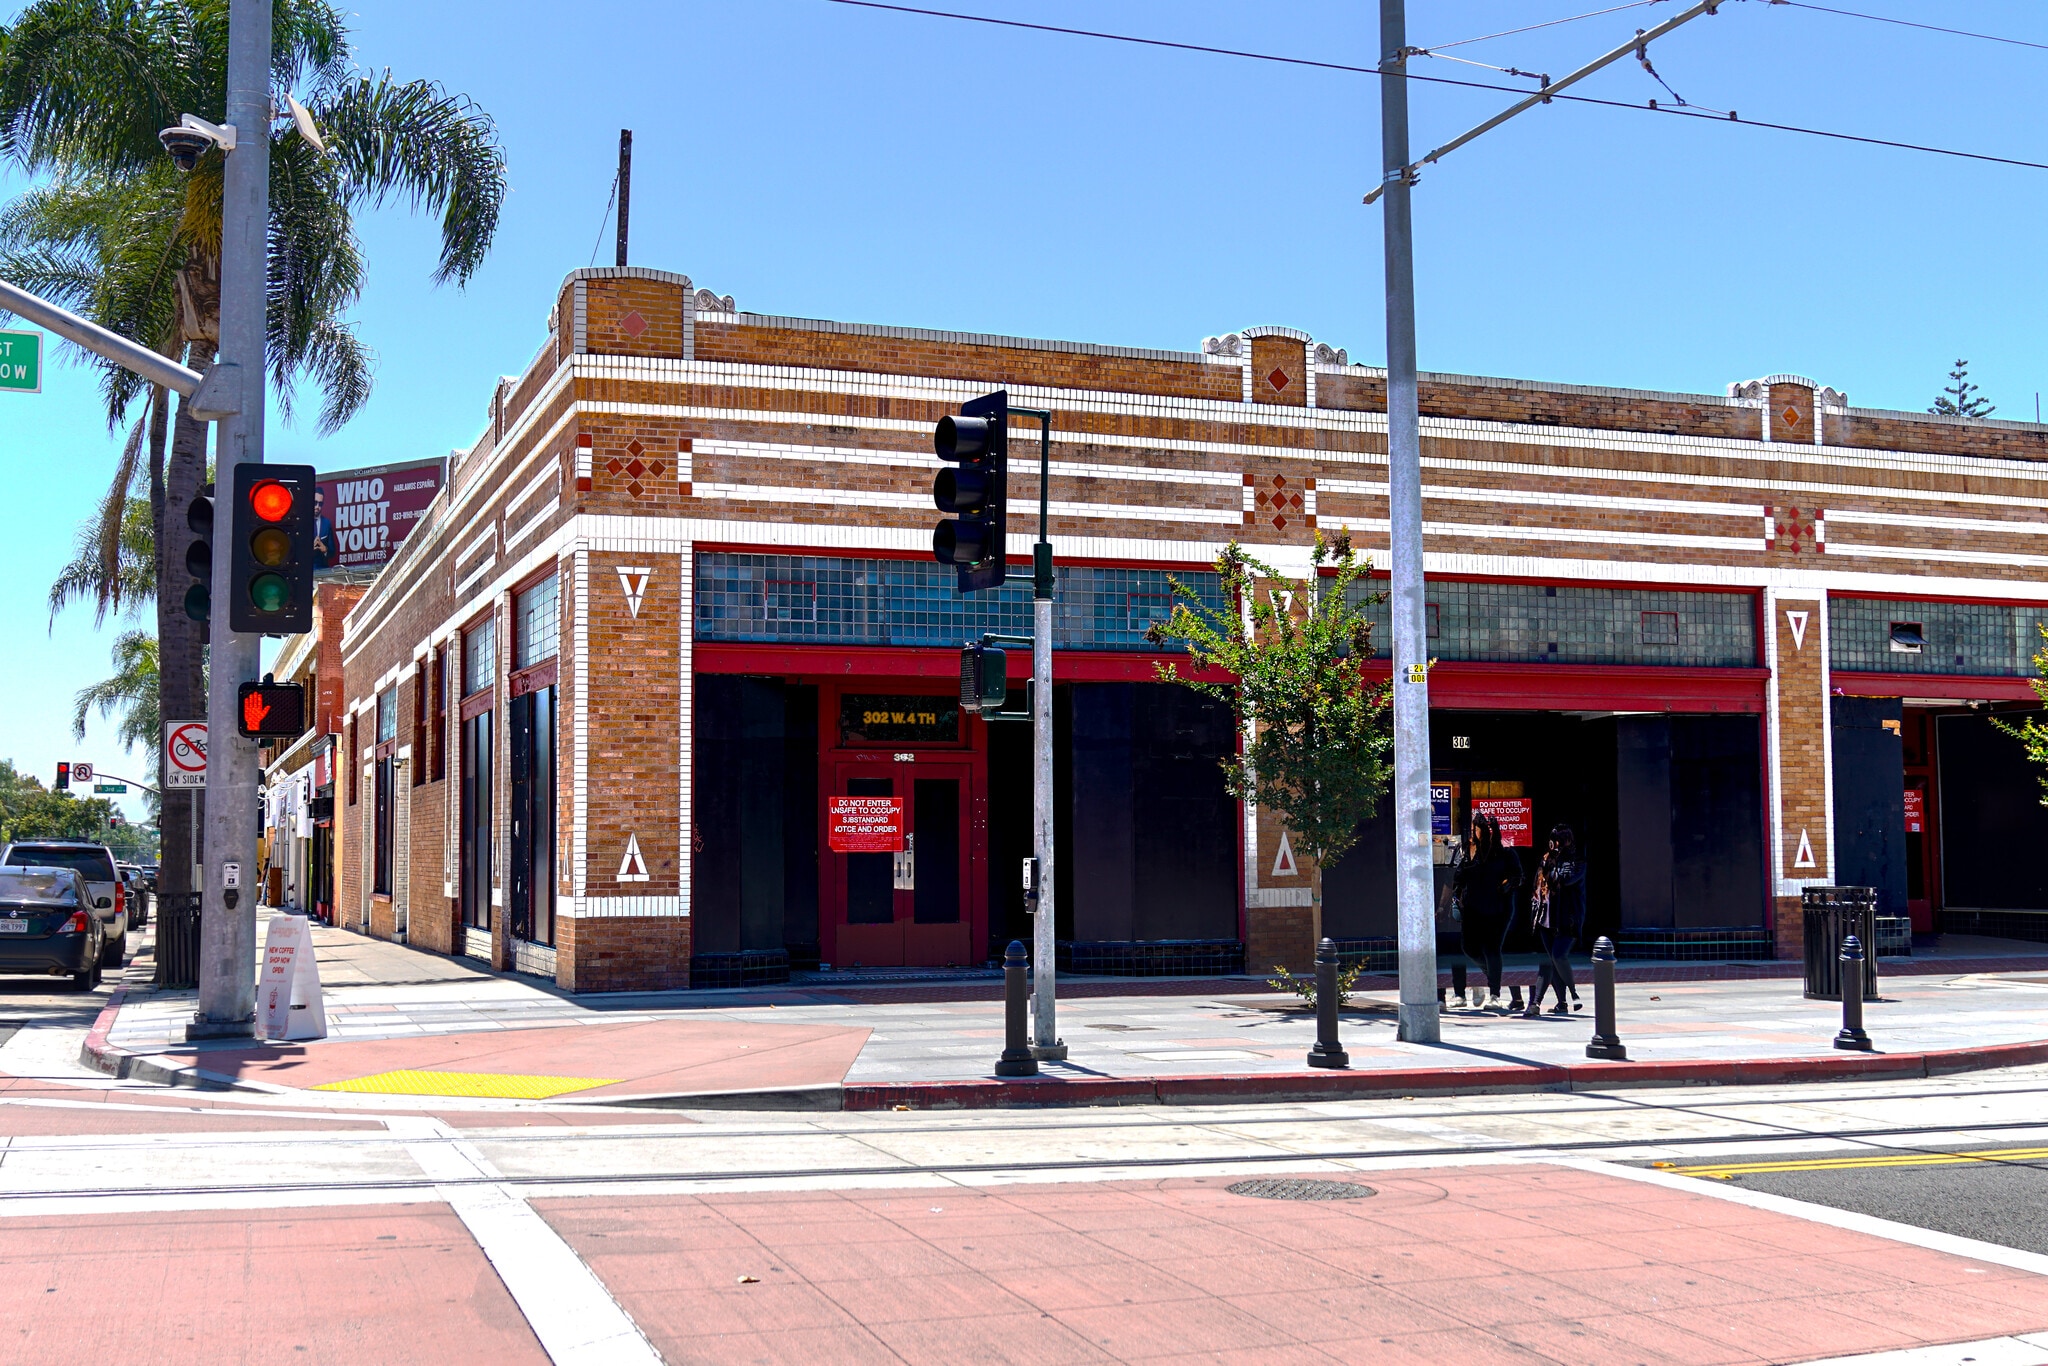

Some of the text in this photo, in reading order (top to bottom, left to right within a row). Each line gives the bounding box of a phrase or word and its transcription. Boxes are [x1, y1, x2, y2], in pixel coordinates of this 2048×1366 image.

[0, 341, 13, 357] T
[337, 478, 384, 504] WHO
[393, 479, 435, 493] HABLAMOS ESPAÑOL
[336, 501, 390, 528] HURT
[336, 525, 390, 552] YOU?
[338, 550, 387, 563] BIG INJURY LAWYERS
[863, 711, 889, 724] 302
[1453, 736, 1470, 749] 304
[168, 774, 179, 785] ON
[838, 799, 892, 807] DO NOT ENTER
[857, 825, 872, 833] AND
[873, 825, 898, 833] ORDER
[269, 956, 280, 964] SHOP
